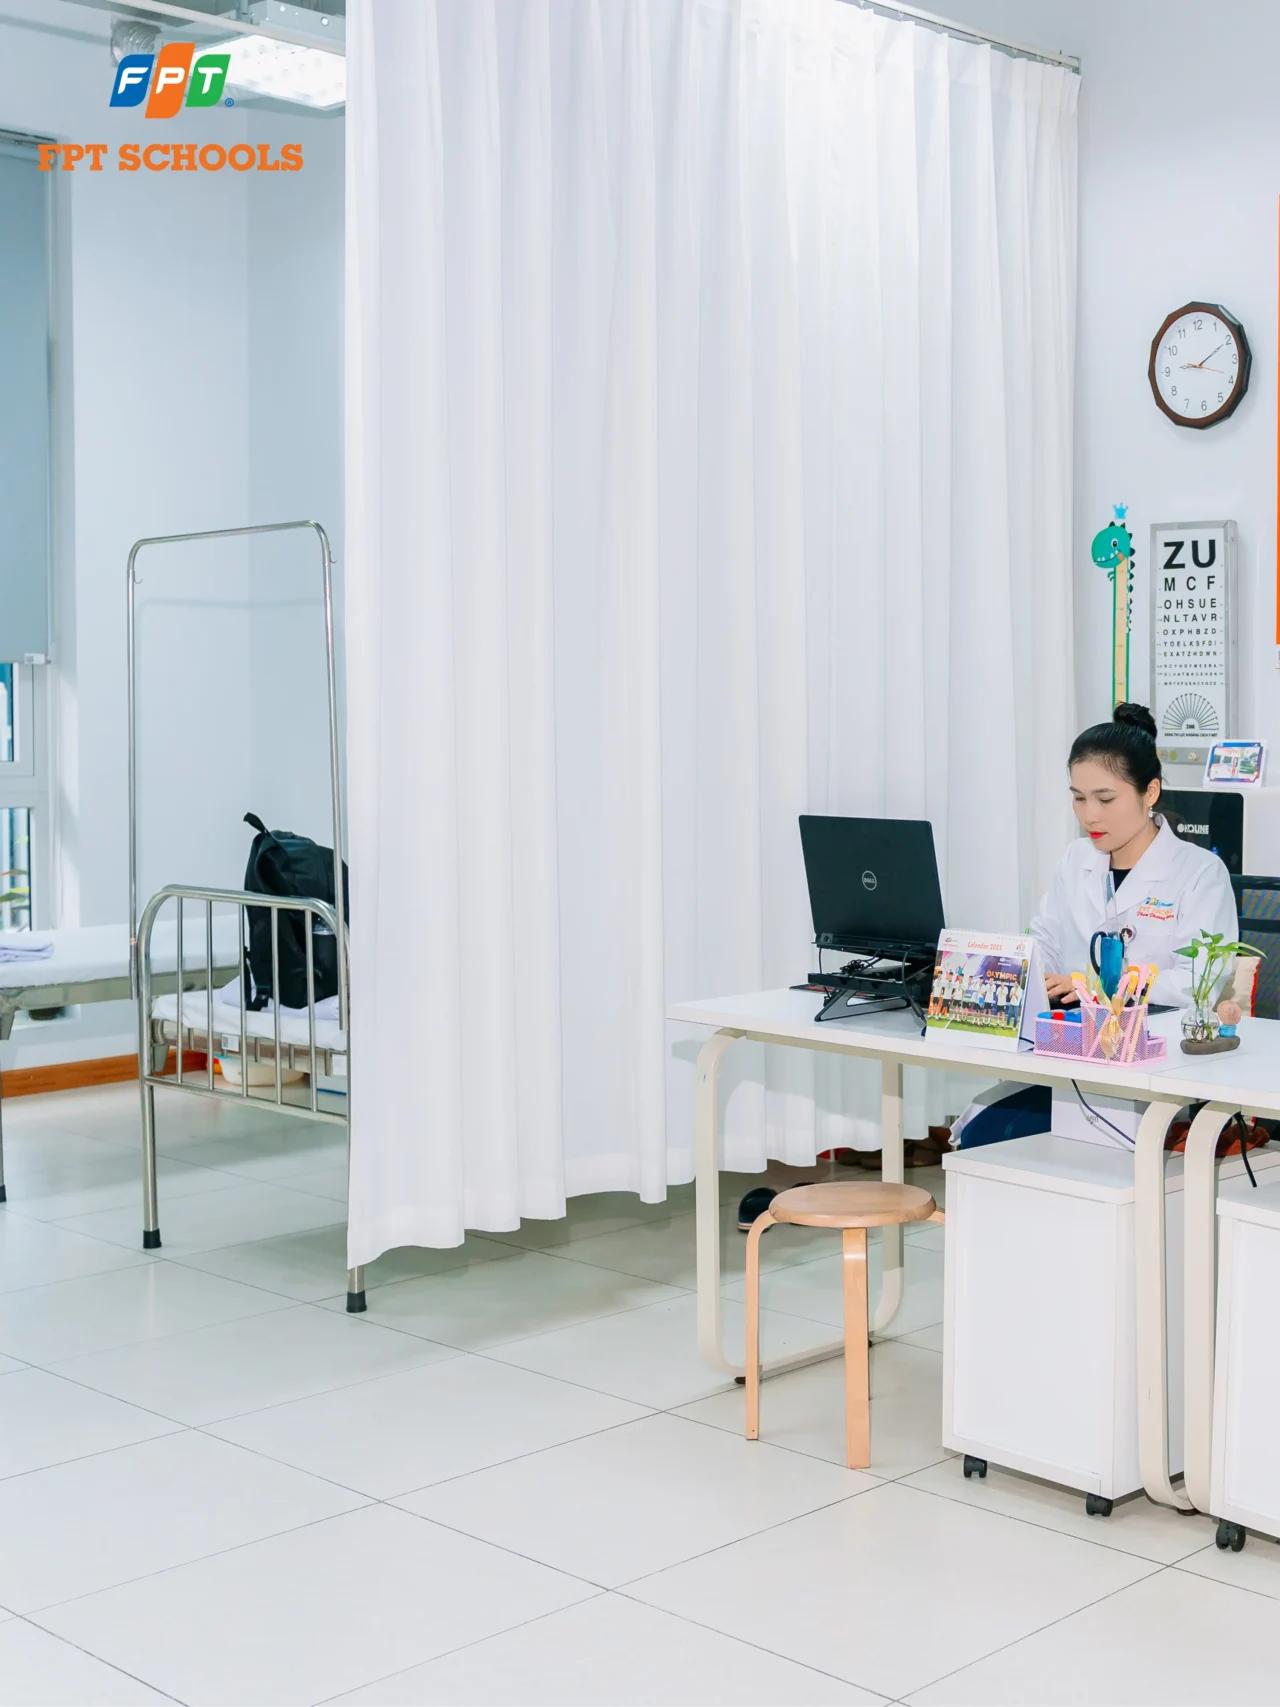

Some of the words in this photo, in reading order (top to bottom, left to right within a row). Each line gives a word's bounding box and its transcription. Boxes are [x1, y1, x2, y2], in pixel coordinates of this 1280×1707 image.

[1192, 319, 1203, 331] 12
[1213, 321, 1217, 332] 1
[1177, 329, 1186, 339] 11
[1225, 334, 1232, 346] 2
[1168, 345, 1178, 356] 10
[1232, 353, 1238, 364] 3
[1164, 366, 1171, 377] 9
[1228, 375, 1234, 385] 4
[1171, 385, 1177, 396] 8
[1217, 392, 1224, 403] 5
[1184, 398, 1190, 409] 7
[1201, 400, 1207, 411] 6
[967, 942, 989, 950] Calendar
[990, 943, 1003, 951] 2025
[986, 970, 1017, 981] OLYMPIC
